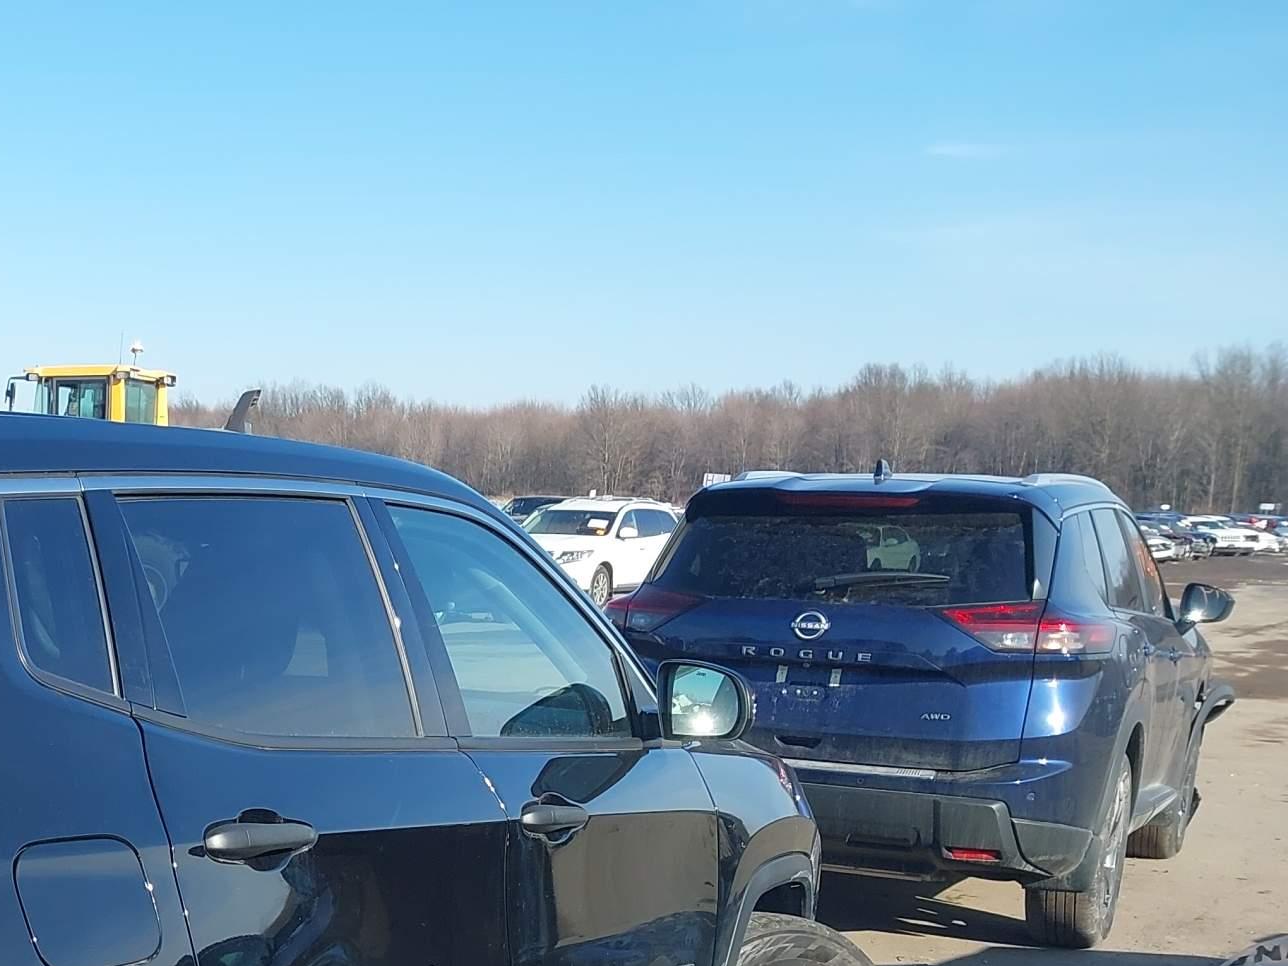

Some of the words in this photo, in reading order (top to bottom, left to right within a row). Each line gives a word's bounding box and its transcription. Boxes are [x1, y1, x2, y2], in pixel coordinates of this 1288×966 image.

[791, 621, 831, 630] NISSAN
[741, 645, 872, 662] ROGUE
[919, 712, 952, 721] AWD
